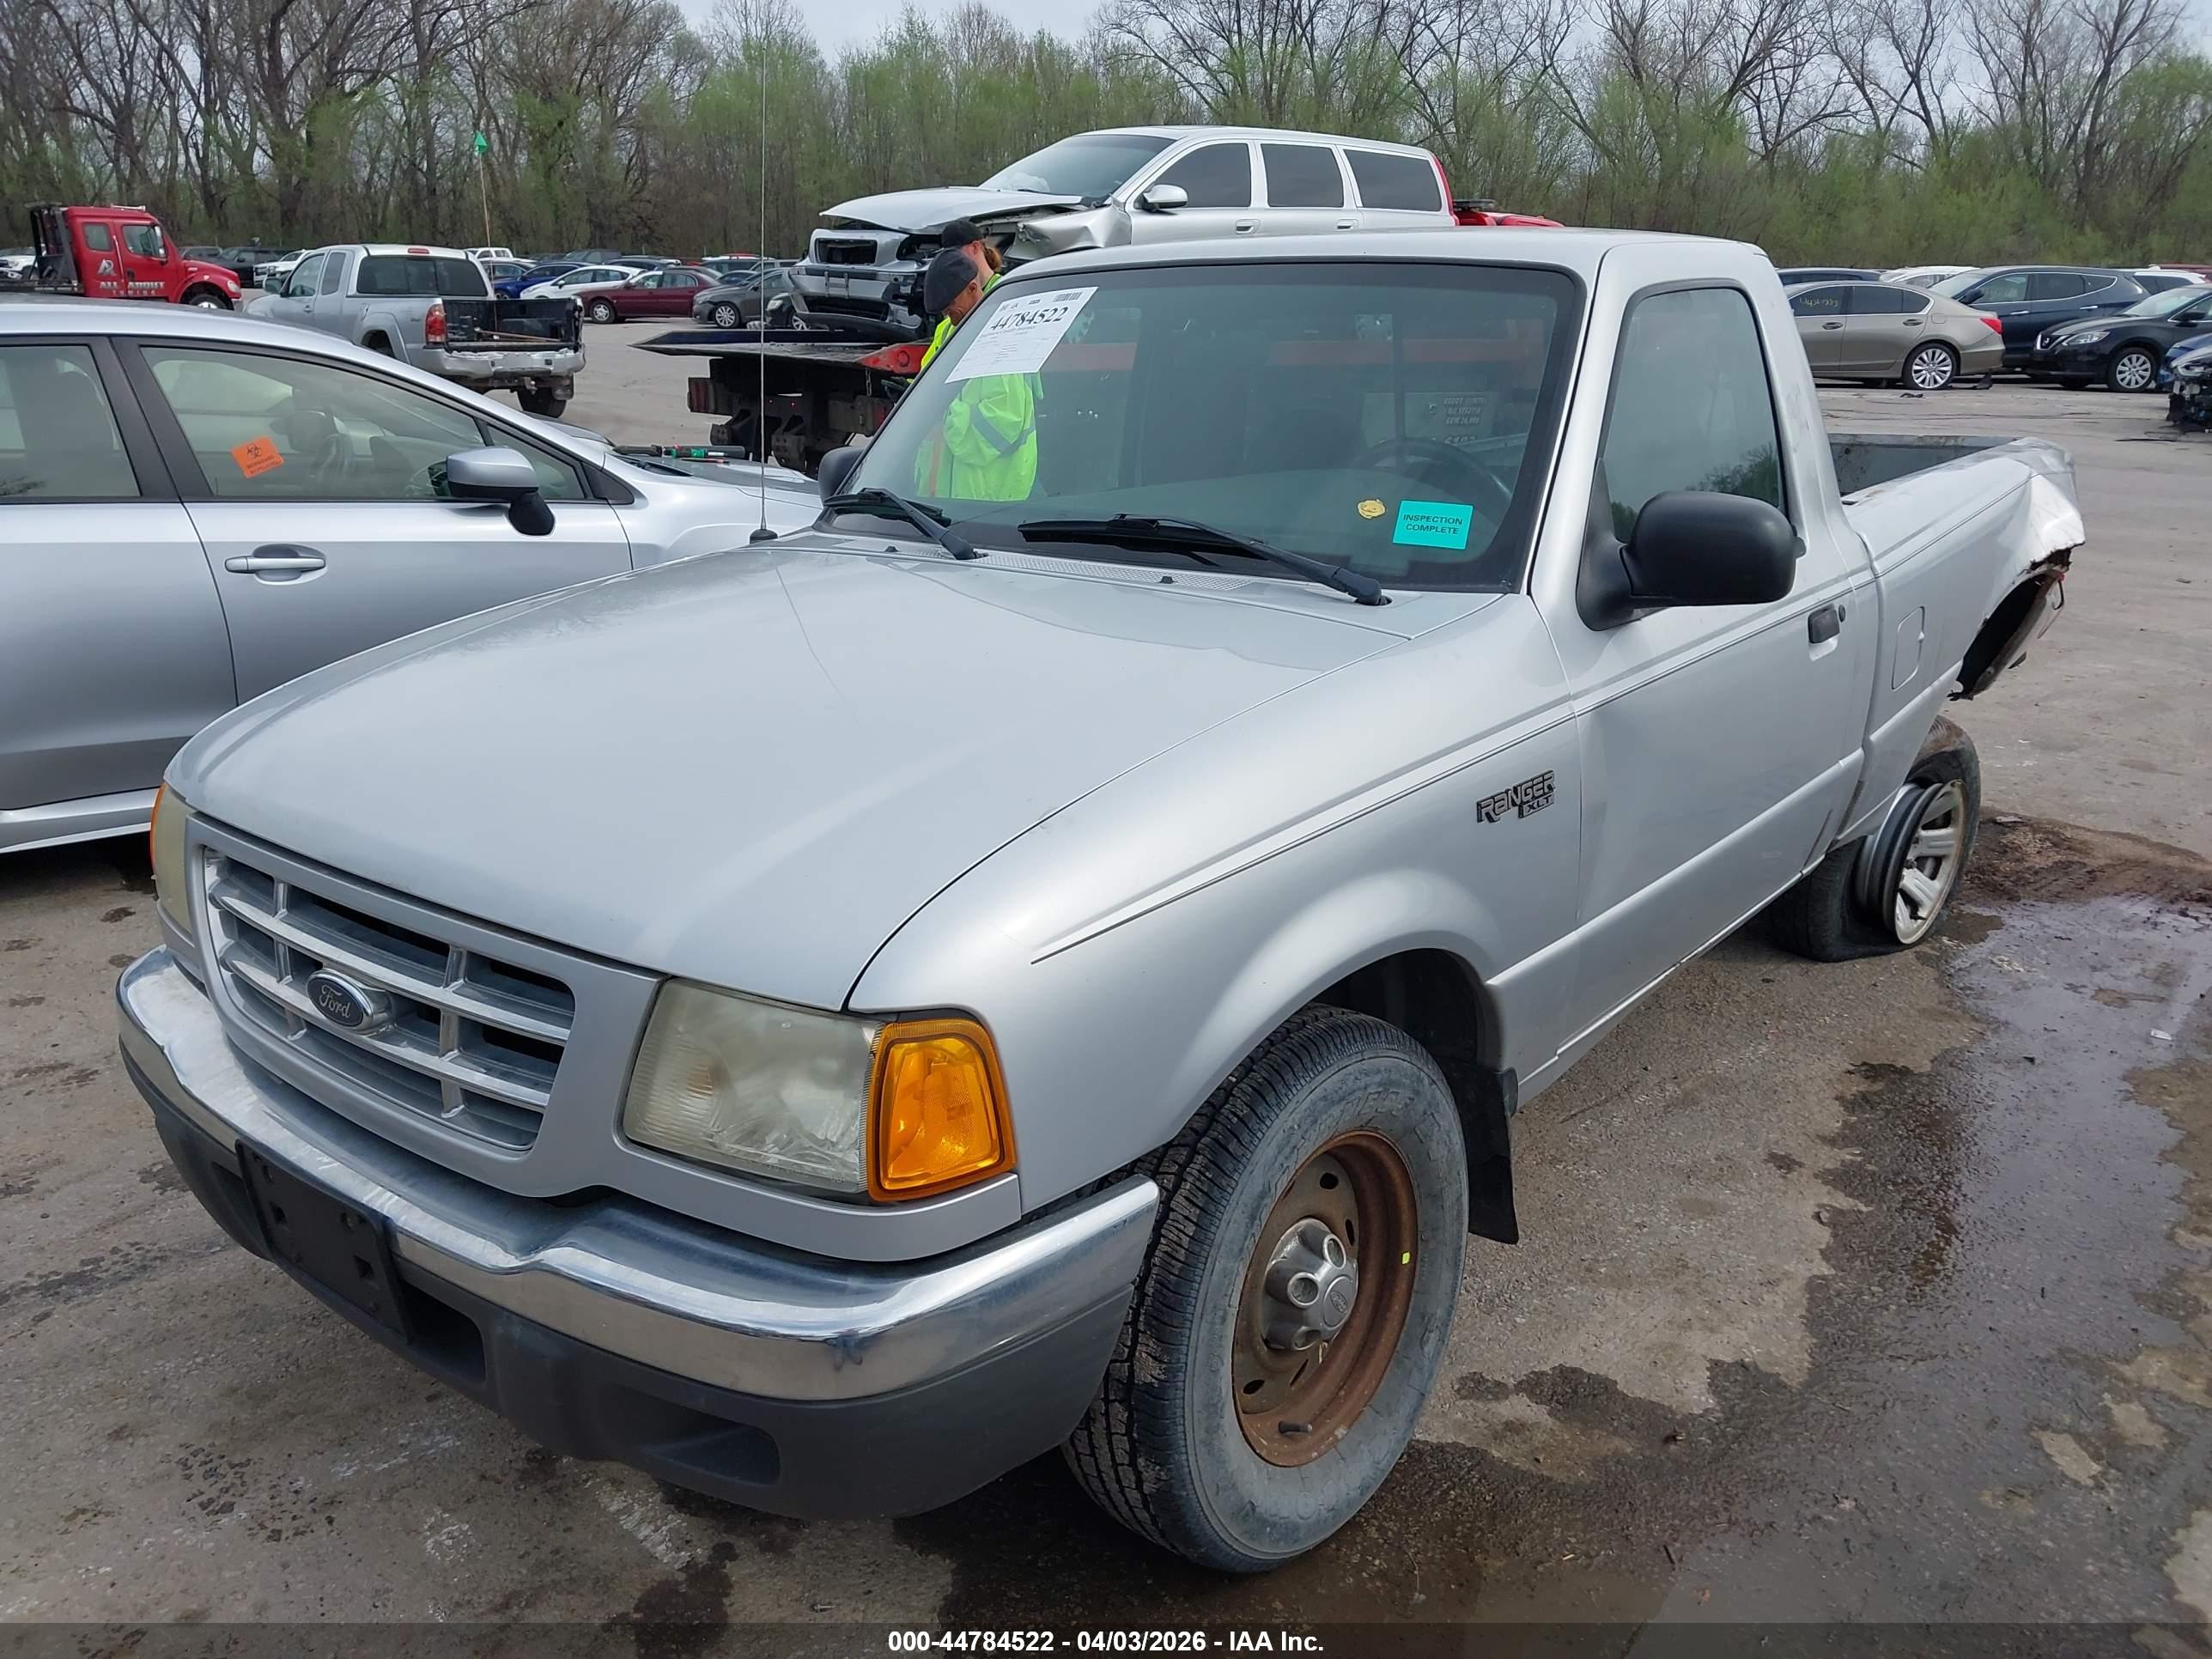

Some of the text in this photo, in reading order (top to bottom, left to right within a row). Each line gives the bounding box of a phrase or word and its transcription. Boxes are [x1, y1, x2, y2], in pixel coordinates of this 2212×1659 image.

[989, 307, 1069, 331] 44784522
[1403, 514, 1463, 526] INSPECTION
[1406, 524, 1460, 534] COMPLETE
[1524, 793, 1553, 816] XLT
[319, 984, 351, 1018] Ford
